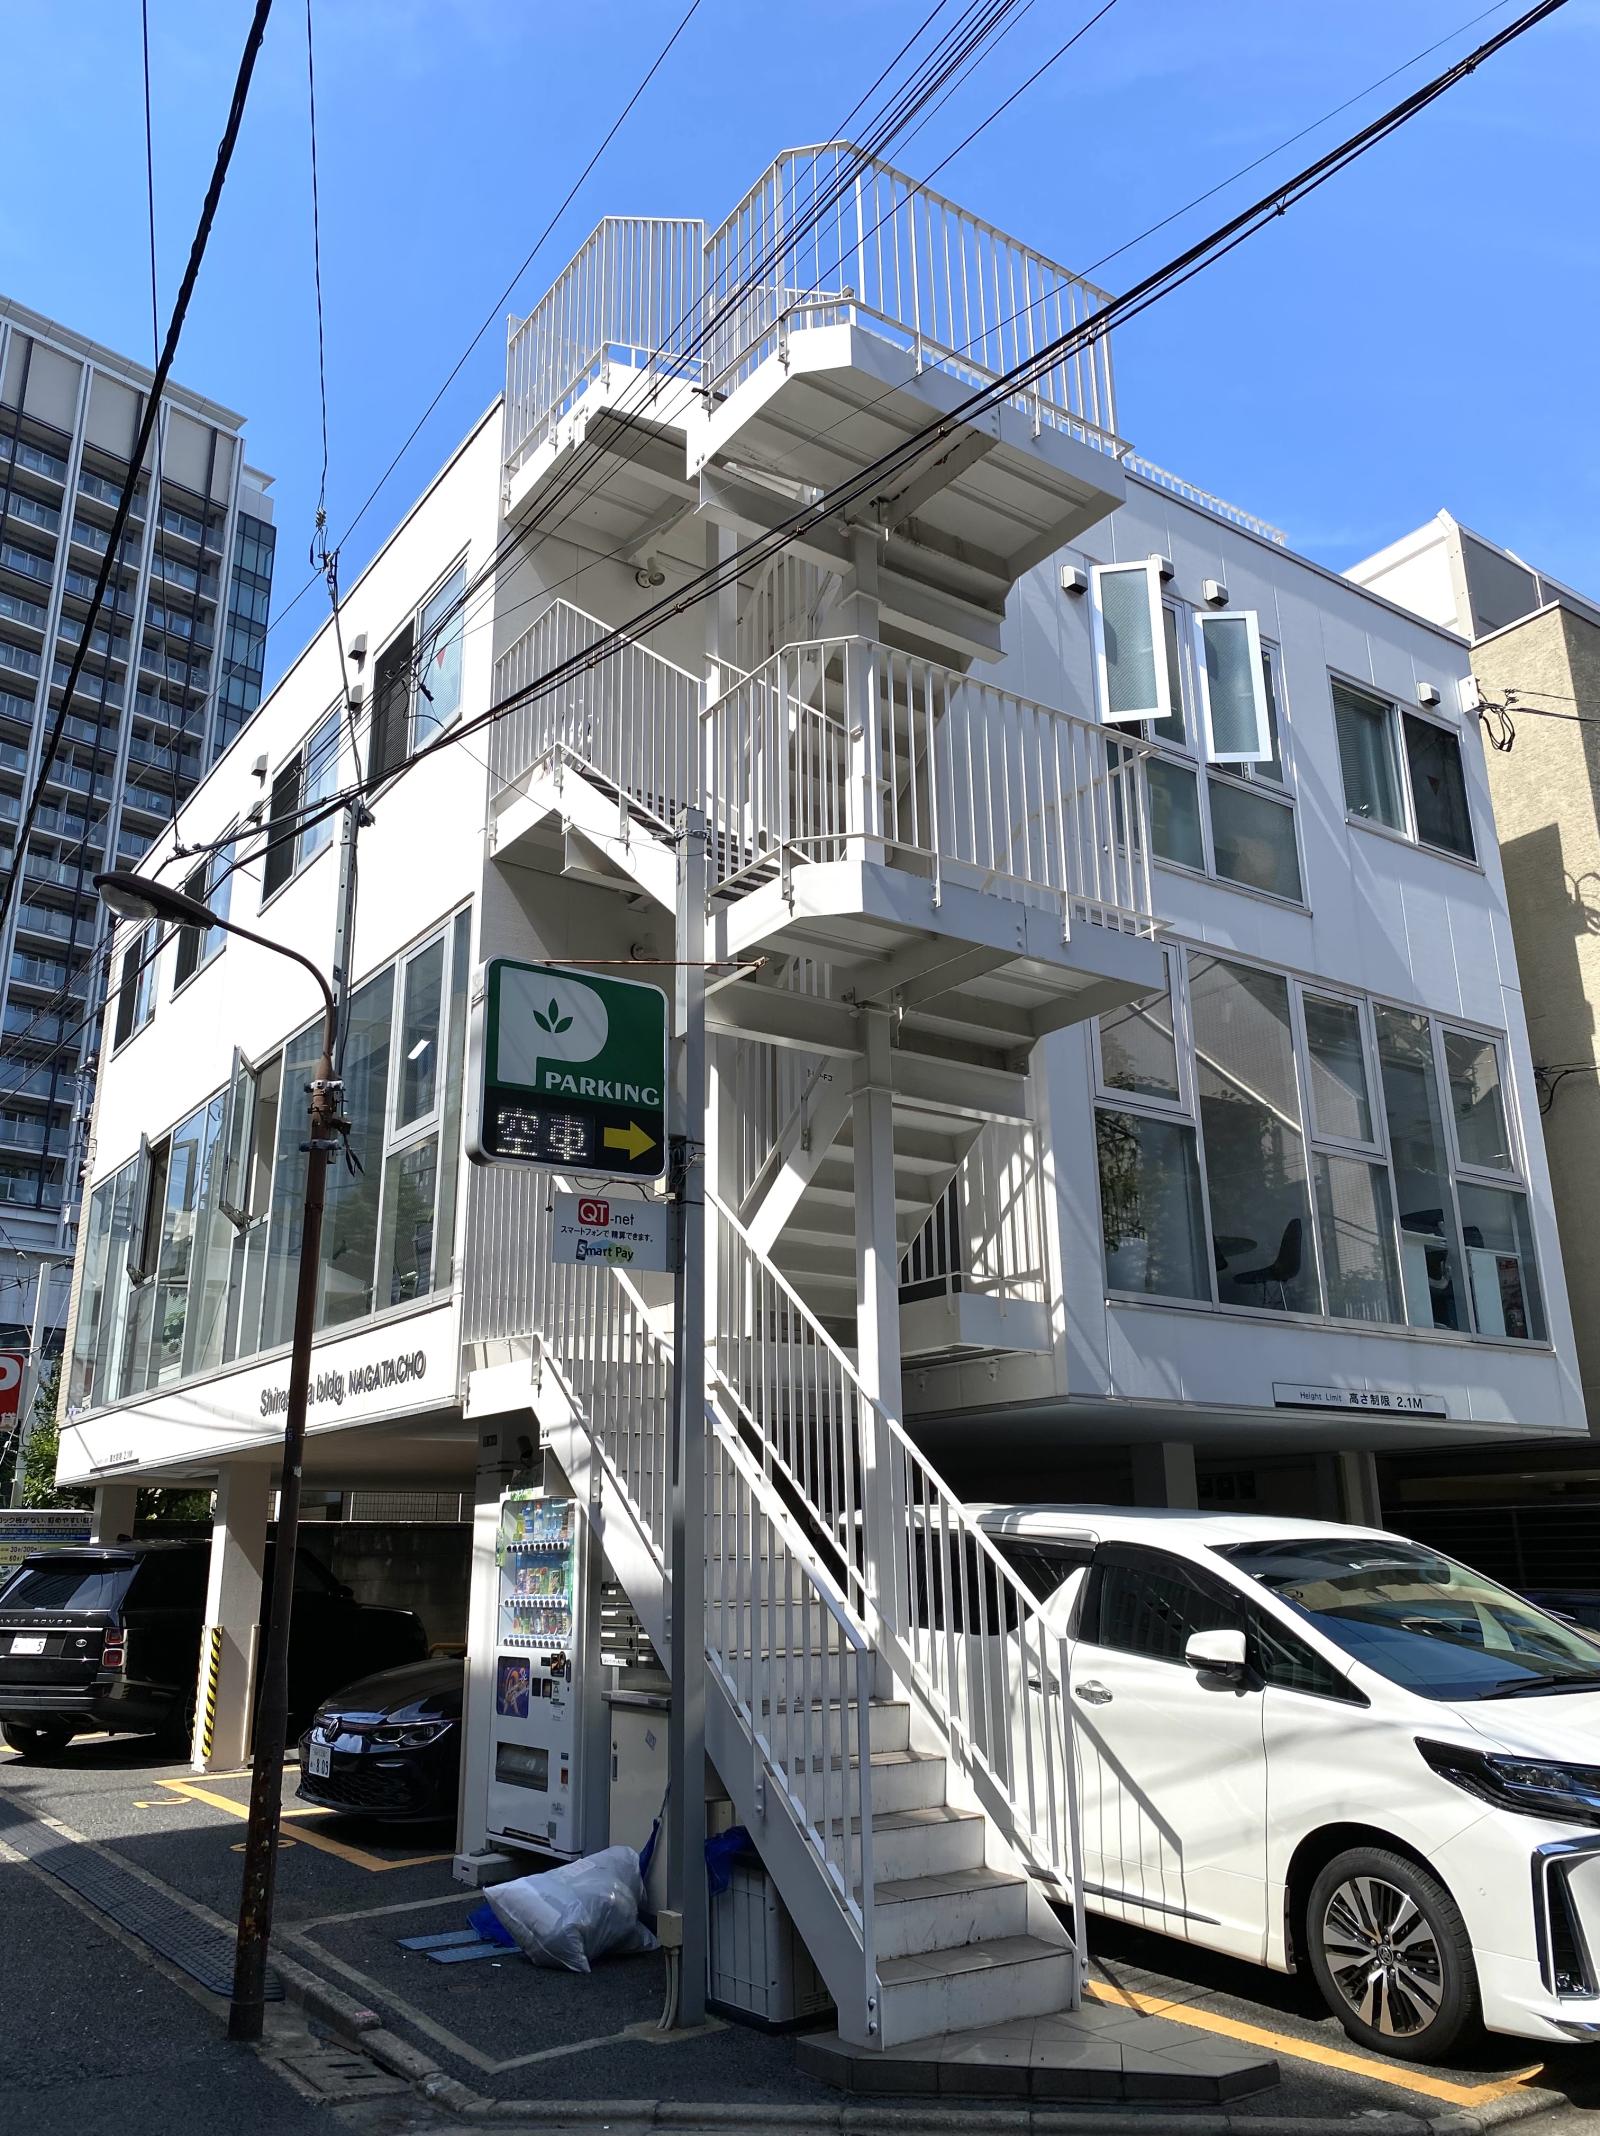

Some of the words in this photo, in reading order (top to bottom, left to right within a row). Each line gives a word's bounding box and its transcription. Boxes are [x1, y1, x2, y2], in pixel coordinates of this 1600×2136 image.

[545, 1071, 660, 1106] PARKING
[496, 1108, 587, 1160] 空車
[577, 1242, 613, 1258] Smart
[615, 1246, 634, 1262] Pay
[349, 1350, 427, 1396] NAGATACHO
[1300, 1391, 1322, 1401] Height
[1325, 1394, 1342, 1402] Limit
[1349, 1393, 1391, 1407] 高さ制限
[1396, 1396, 1424, 1409] 2.1M
